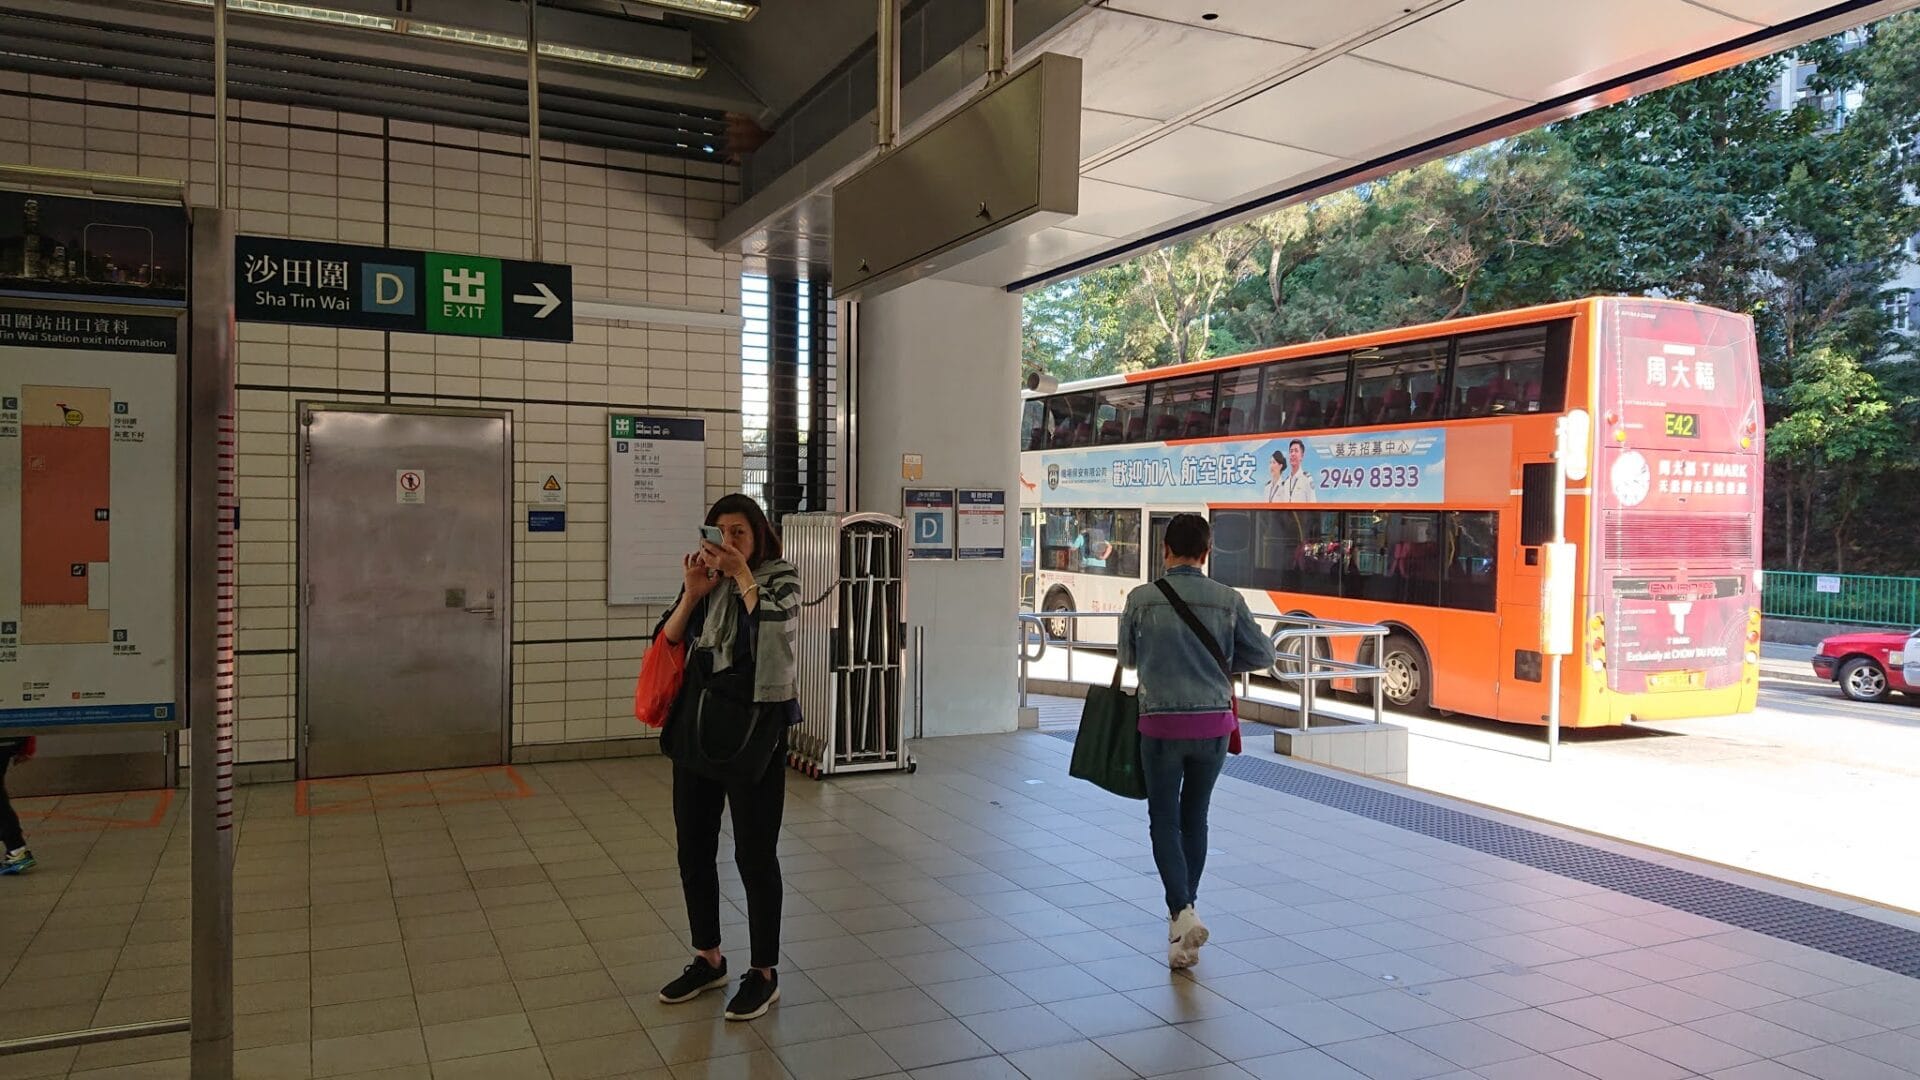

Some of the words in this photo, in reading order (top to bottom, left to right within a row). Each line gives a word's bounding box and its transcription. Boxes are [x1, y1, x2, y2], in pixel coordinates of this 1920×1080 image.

[244, 254, 349, 291] 沙田圍
[375, 271, 404, 305] D
[255, 290, 286, 307] Sha
[289, 292, 316, 308] Tin
[320, 295, 350, 311] Wai
[444, 304, 485, 319] EXIT
[17, 331, 39, 341] Wai
[41, 333, 80, 344] Station
[82, 336, 102, 345] exit
[105, 337, 166, 348] information
[1646, 356, 1716, 391] 周大福
[117, 403, 125, 413] D
[1665, 413, 1694, 436] E42
[619, 443, 627, 451] D
[1112, 458, 1176, 487] 歡迎加入
[1180, 454, 1257, 486] 航空保安
[1320, 467, 1365, 489] 2949
[1370, 465, 1419, 488] 8333
[922, 518, 937, 538] D
